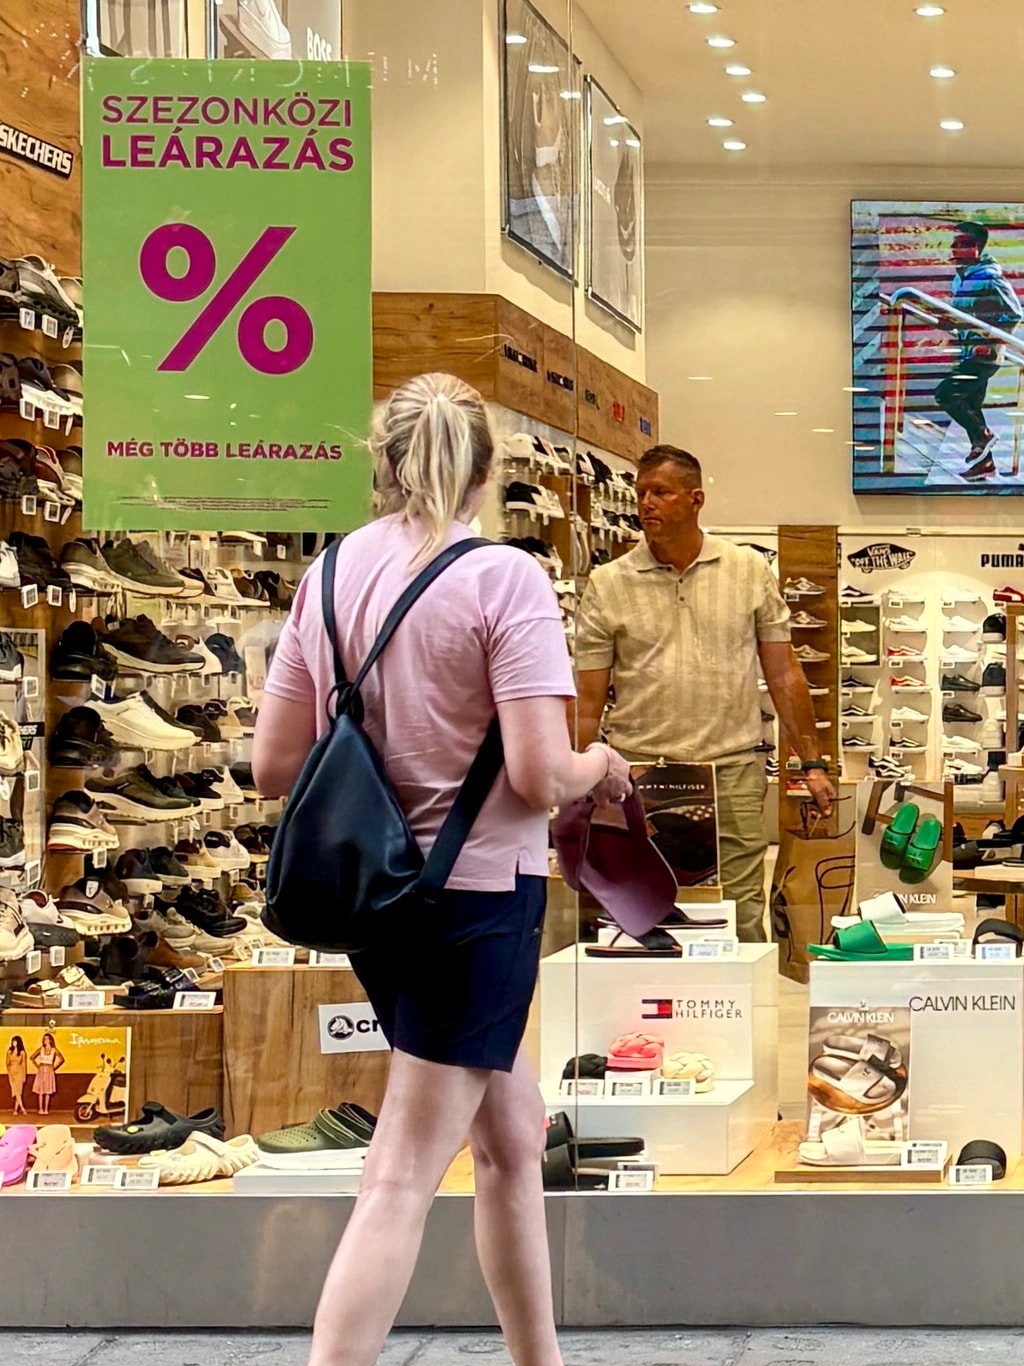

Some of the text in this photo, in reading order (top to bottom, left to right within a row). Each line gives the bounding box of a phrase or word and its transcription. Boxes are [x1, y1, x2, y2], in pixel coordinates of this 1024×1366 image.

[102, 92, 351, 127] SZEZONKÖZI
[0, 124, 73, 174] SKECHERS
[102, 127, 354, 171] LEÁRAZÁS
[139, 223, 314, 375] %
[107, 437, 343, 460] MÉG TÖBB LEÁRAZÁS
[866, 544, 891, 557] VANS
[981, 553, 1024, 568] PUMA
[909, 893, 937, 904] KLEIN
[675, 999, 736, 1009] TOMMY
[908, 995, 1016, 1012] CALVIN KLEIN
[675, 1009, 743, 1018] HILFIGER
[827, 1012, 895, 1024] CALVIN KLEIN
